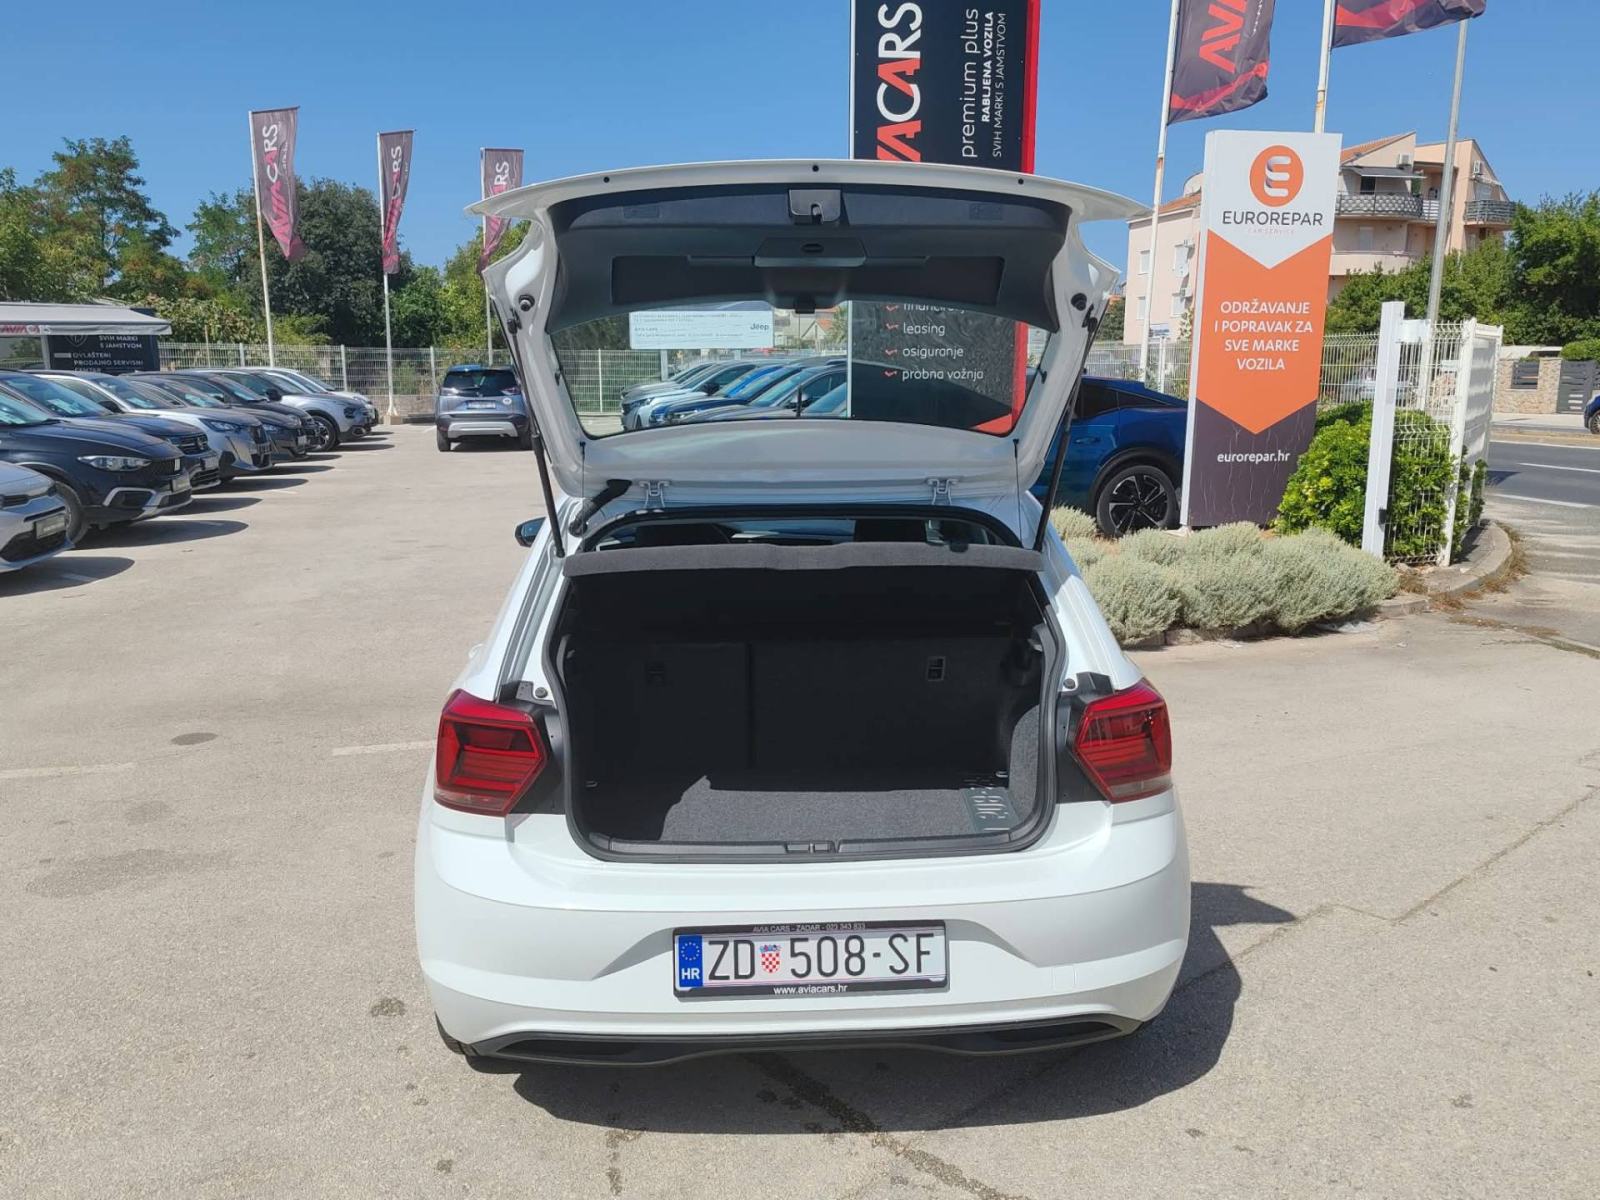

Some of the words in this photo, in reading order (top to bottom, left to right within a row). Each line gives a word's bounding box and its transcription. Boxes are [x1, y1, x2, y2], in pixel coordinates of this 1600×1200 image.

[960, 8, 981, 54] plus
[983, 11, 994, 57] VOZILA
[996, 13, 1007, 80] JAMSTVOM
[981, 60, 993, 122] RABLJENA
[994, 81, 1005, 90] S
[960, 61, 978, 158] premium
[994, 91, 1004, 129] MARKI
[992, 131, 1003, 158] SVIH
[1222, 210, 1324, 226] EUROREPAR
[1220, 299, 1311, 314] ODRŽAVANJE
[750, 323, 770, 331] Jeep
[903, 322, 946, 336] leasing
[1214, 320, 1219, 333] I
[1221, 320, 1293, 333] POPRAVAK
[1295, 320, 1313, 333] ZA
[902, 344, 964, 359] osiguranje
[1224, 339, 1249, 352] SVE
[1252, 339, 1299, 352] MARKE
[1236, 358, 1286, 370] VOZILA
[902, 368, 944, 381] probna
[947, 368, 984, 382] vožnja
[1217, 449, 1291, 465] eurorepar.hr
[770, 925, 790, 933] CARS
[796, 924, 820, 932] ZADAR
[708, 939, 756, 981] ZD
[790, 933, 936, 979] 508-SF
[681, 967, 700, 980] HR
[773, 983, 848, 996] www.aviacars.hr
